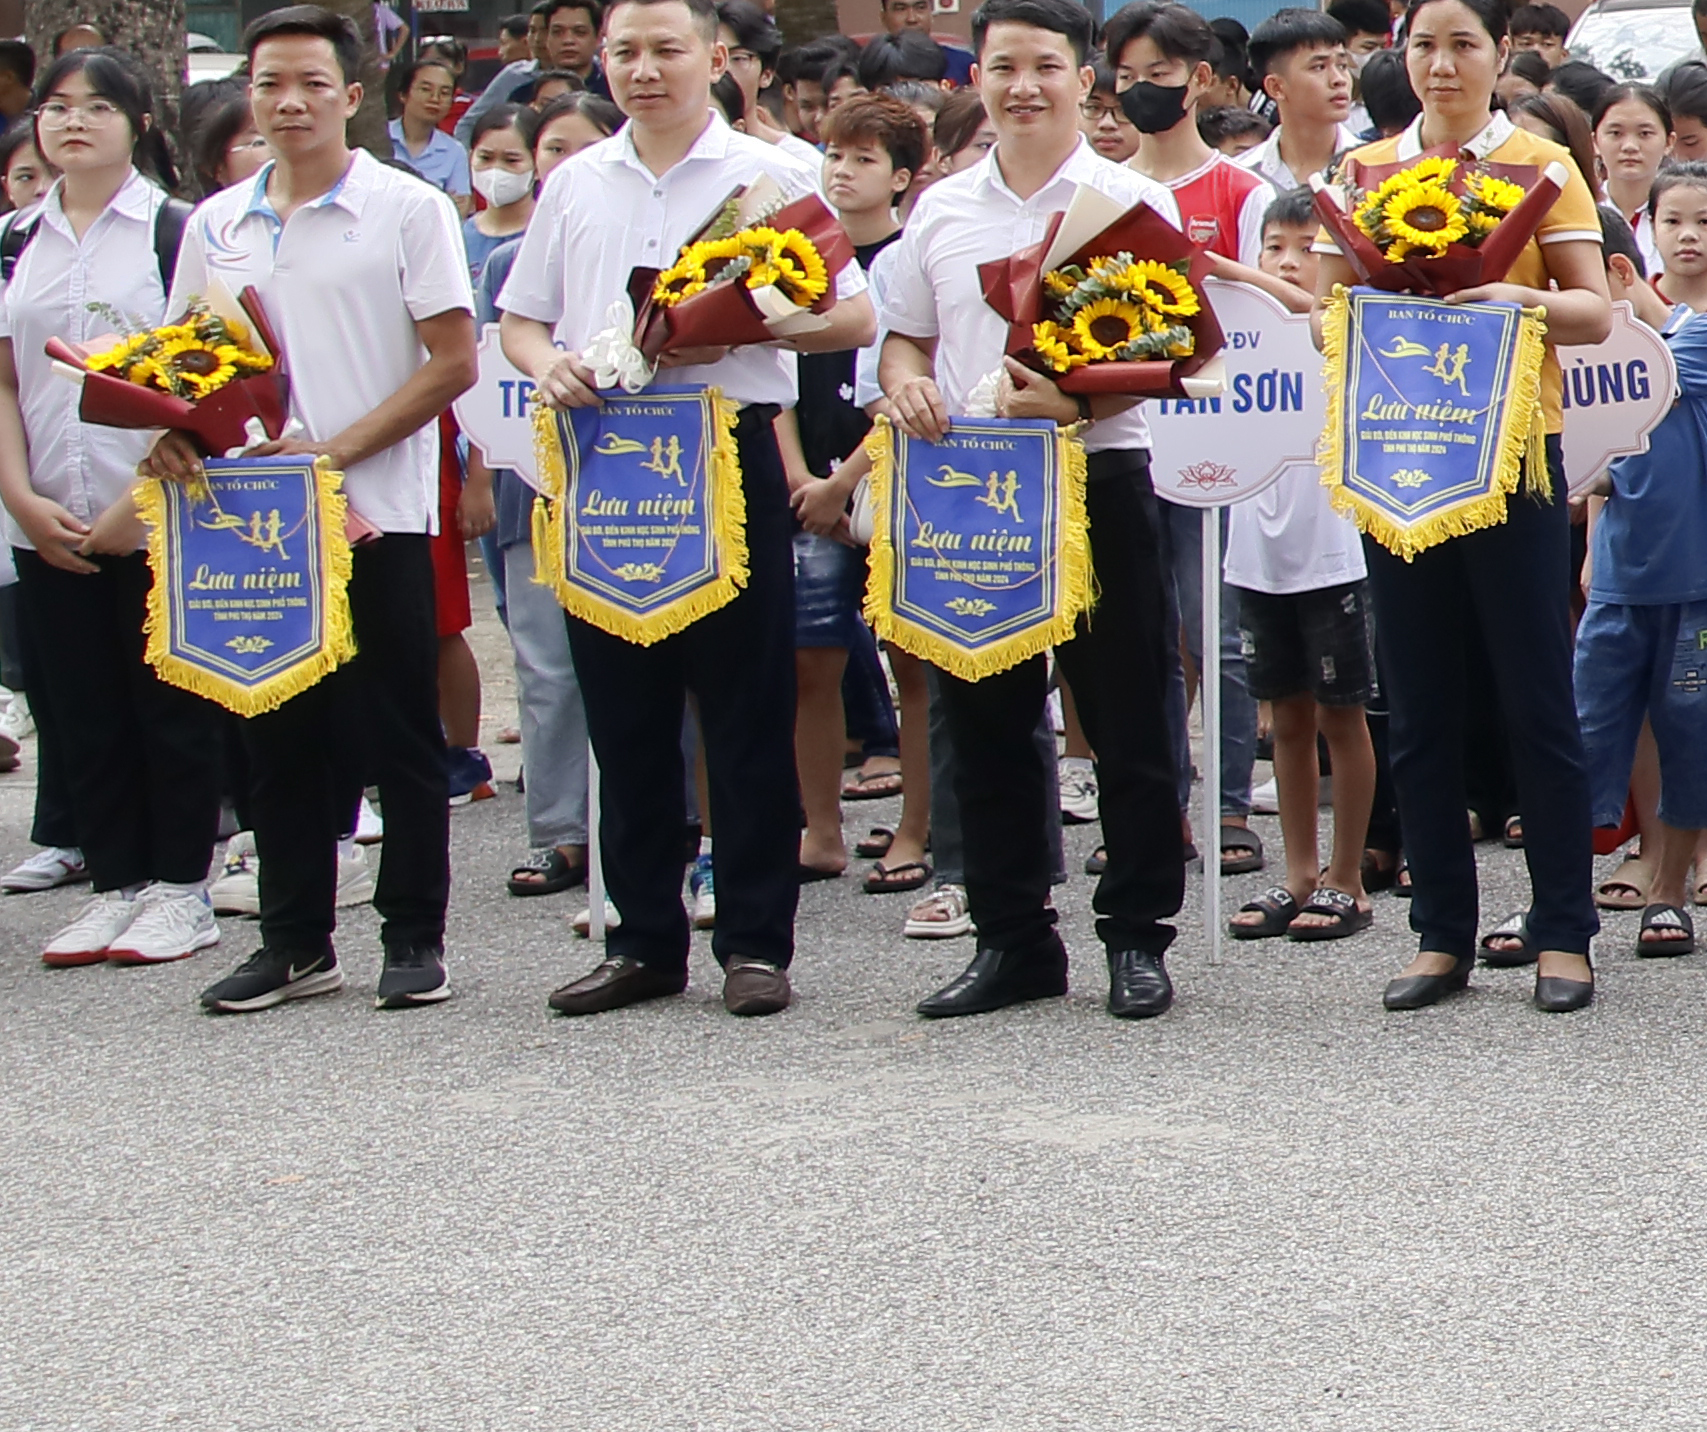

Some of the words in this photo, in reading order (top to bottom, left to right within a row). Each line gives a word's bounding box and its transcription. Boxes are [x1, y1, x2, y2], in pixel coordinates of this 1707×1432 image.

[1388, 309, 1413, 319] BAN
[1416, 308, 1435, 321] TỔ
[1437, 312, 1476, 326] CHỨC
[1233, 368, 1303, 413] SƠN
[1361, 393, 1408, 420] Lưu
[1415, 398, 1477, 427] niệm
[581, 488, 629, 516] Lưu
[637, 493, 697, 521] niệm
[911, 521, 962, 549] Lưu
[970, 528, 1032, 557] niệm
[188, 563, 236, 590] Lưu
[243, 567, 302, 595] niệm
